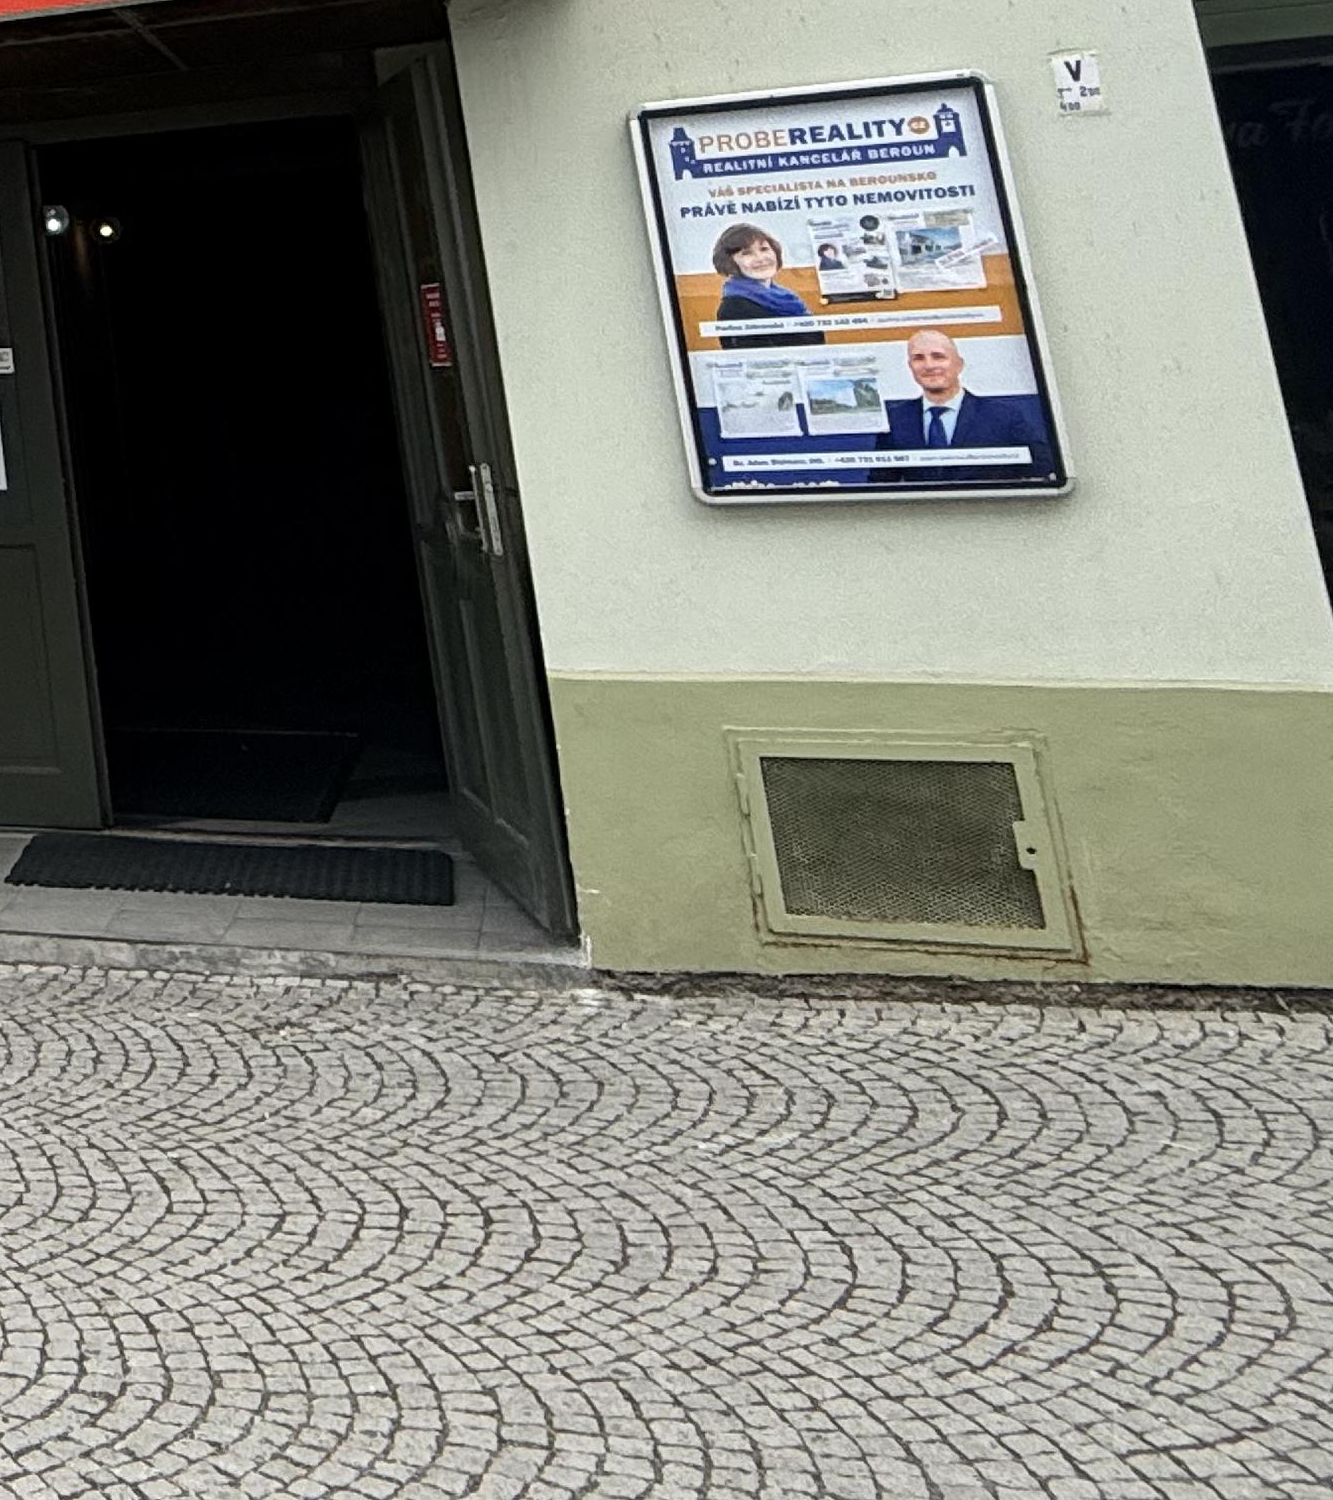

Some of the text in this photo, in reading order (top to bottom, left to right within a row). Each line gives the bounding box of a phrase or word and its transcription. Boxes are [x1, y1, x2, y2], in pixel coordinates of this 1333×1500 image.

[703, 143, 936, 174] REALITNÍ KANCELÁŘ BEROUN
[680, 184, 976, 219] PRÁVĚ NABÍZÍ TYTO NEMOVITOSTI
[737, 181, 823, 197] SPECIALISTA
[826, 177, 848, 188] NA
